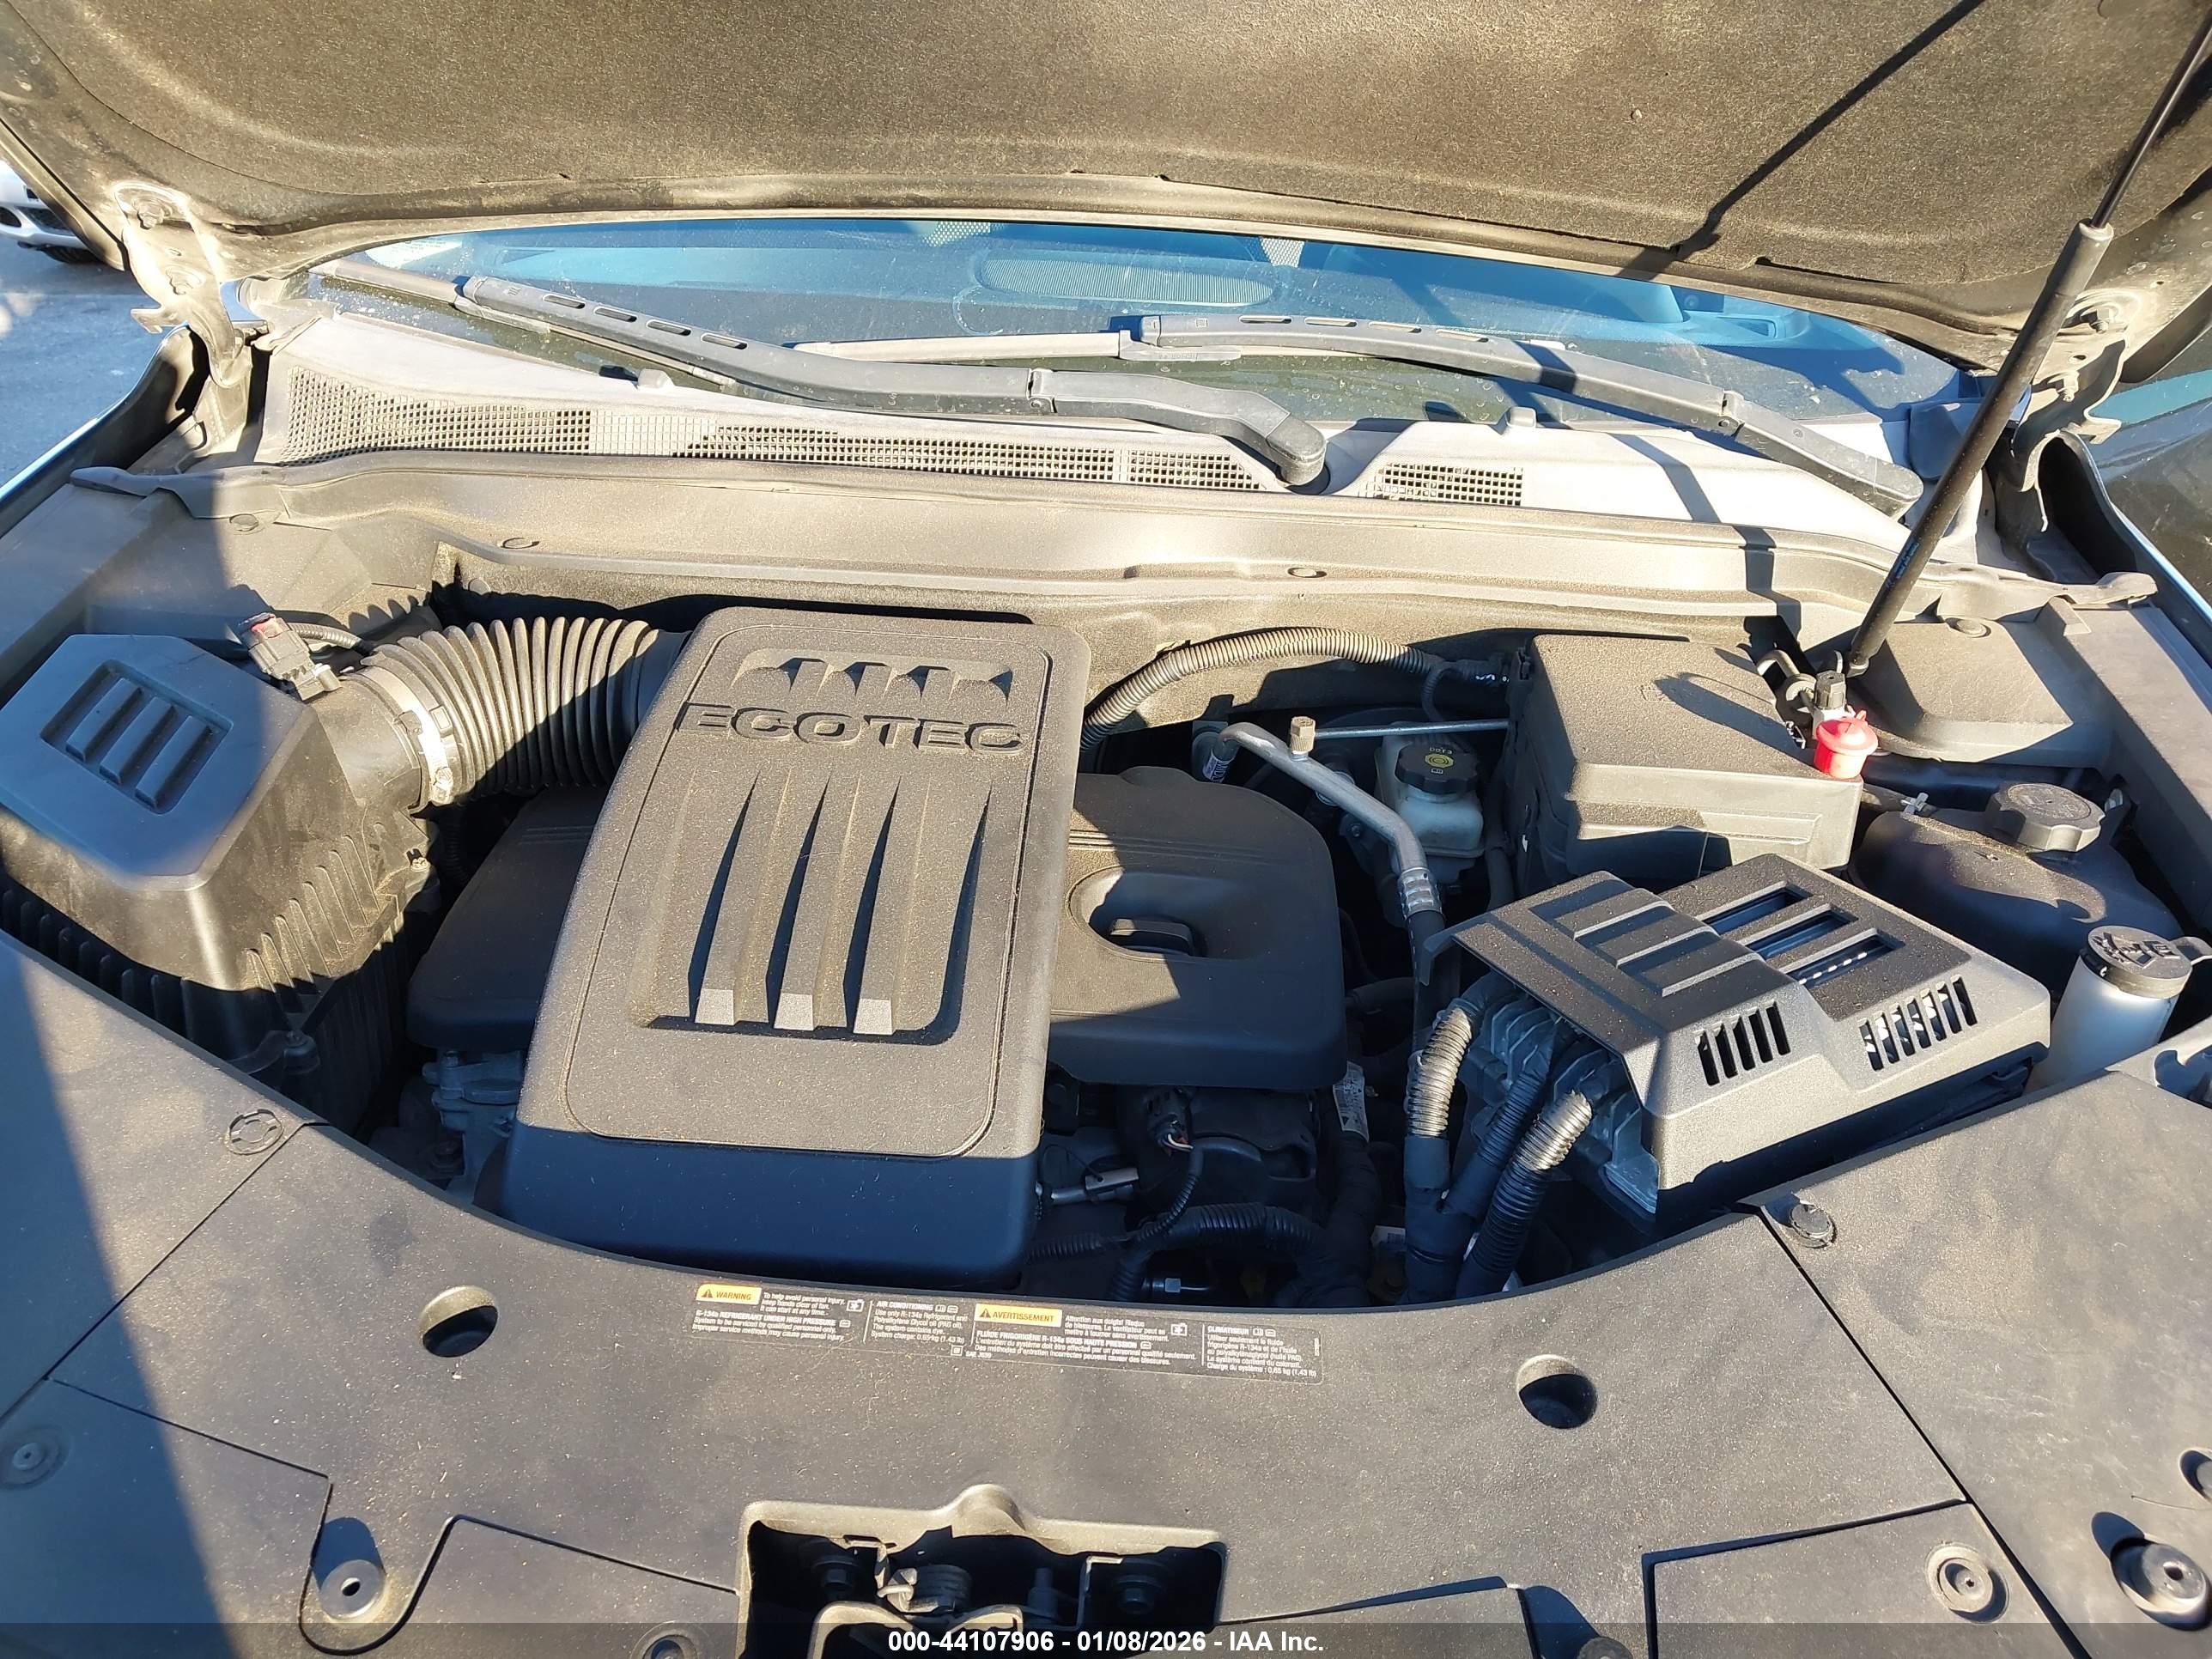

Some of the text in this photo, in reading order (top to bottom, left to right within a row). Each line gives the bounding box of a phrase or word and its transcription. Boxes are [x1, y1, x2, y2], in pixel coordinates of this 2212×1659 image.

[676, 701, 1027, 755] ECOTEC
[716, 1291, 751, 1300] WARNING
[890, 1302, 933, 1310] CONDITIONING
[720, 1312, 763, 1321] REFRIGERANT
[993, 1311, 1054, 1322] AVERTISSEMENT
[694, 1317, 716, 1326] System
[767, 1323, 793, 1332] qualified
[874, 1316, 909, 1325] Polyalkylene
[910, 1318, 927, 1327] Glycol
[692, 1324, 719, 1334] Improper
[827, 1333, 844, 1341] injury.
[884, 1324, 906, 1333] system
[1207, 1326, 1249, 1334] CLIMATISEUR
[871, 1330, 892, 1339] System
[894, 1332, 915, 1340] charge:
[988, 1345, 1017, 1353] méthodes
[1016, 1340, 1041, 1349] système
[1238, 1364, 1263, 1373] système
